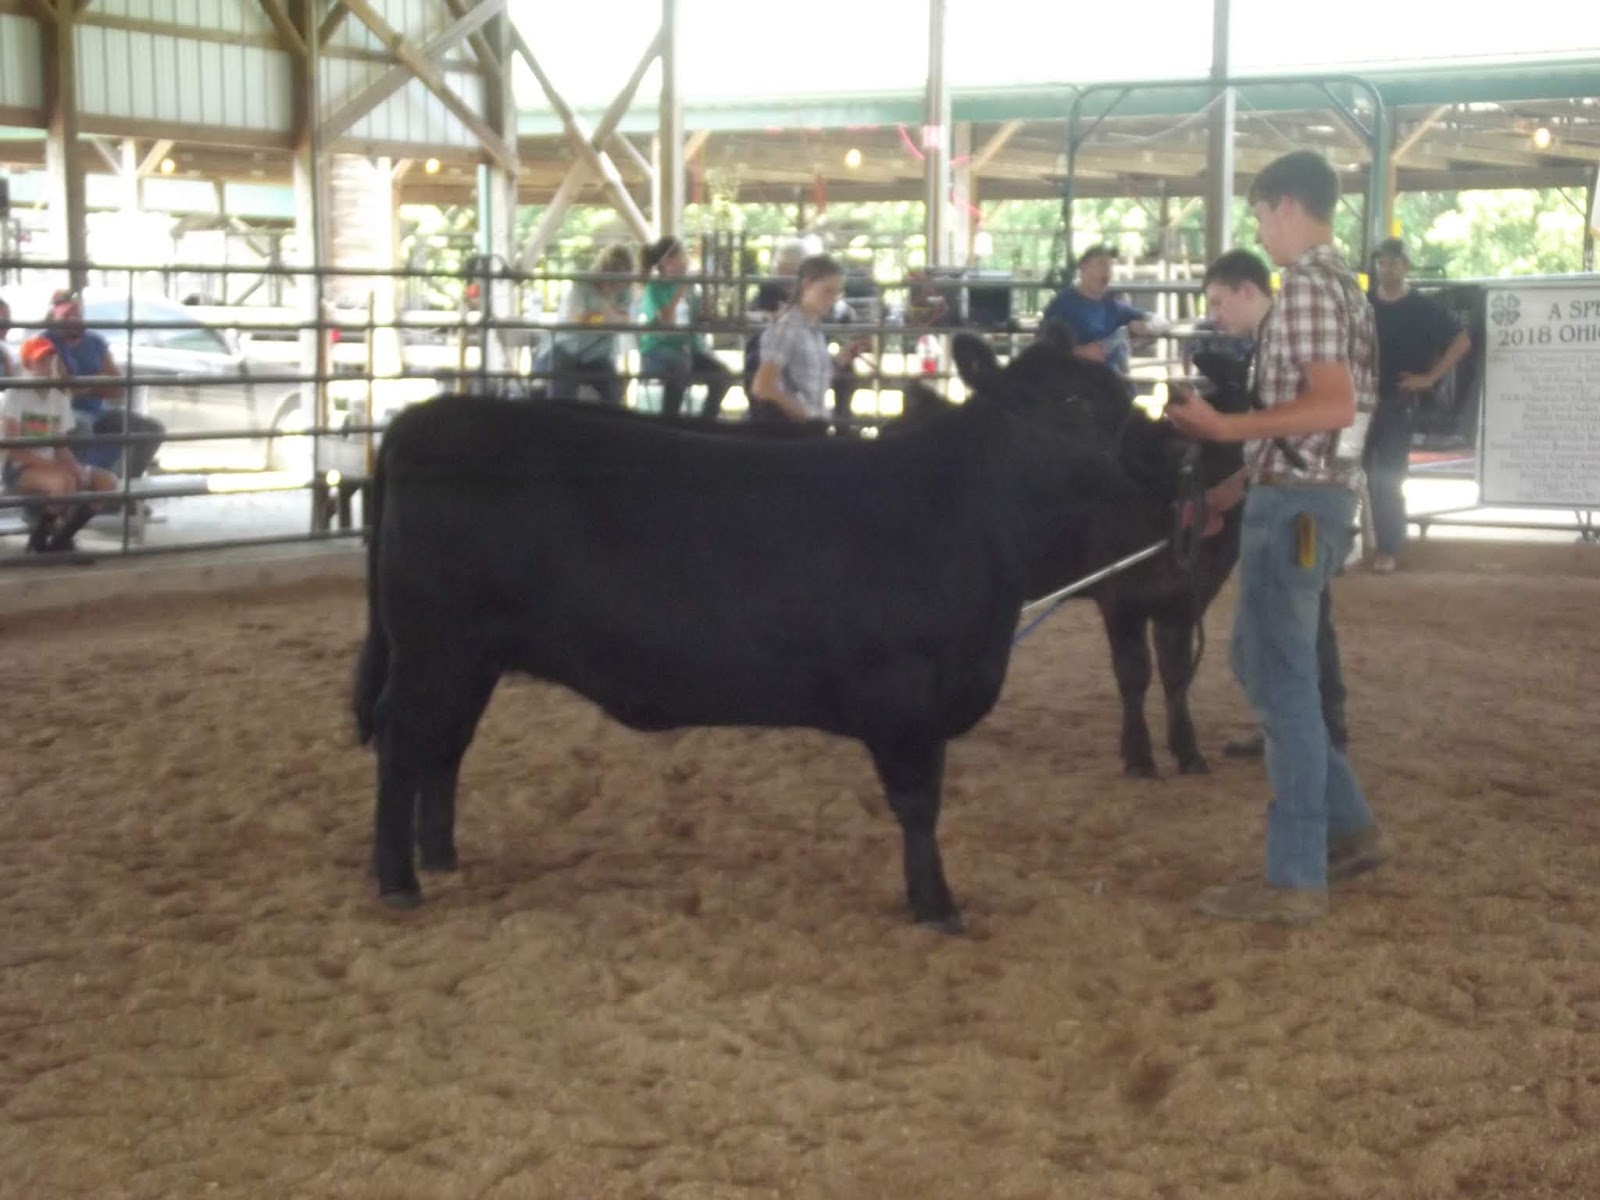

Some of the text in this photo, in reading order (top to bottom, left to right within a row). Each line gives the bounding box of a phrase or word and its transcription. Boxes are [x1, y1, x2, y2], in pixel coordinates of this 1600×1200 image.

[1548, 302, 1562, 320] A
[1498, 324, 1600, 346] 2018 OHI
